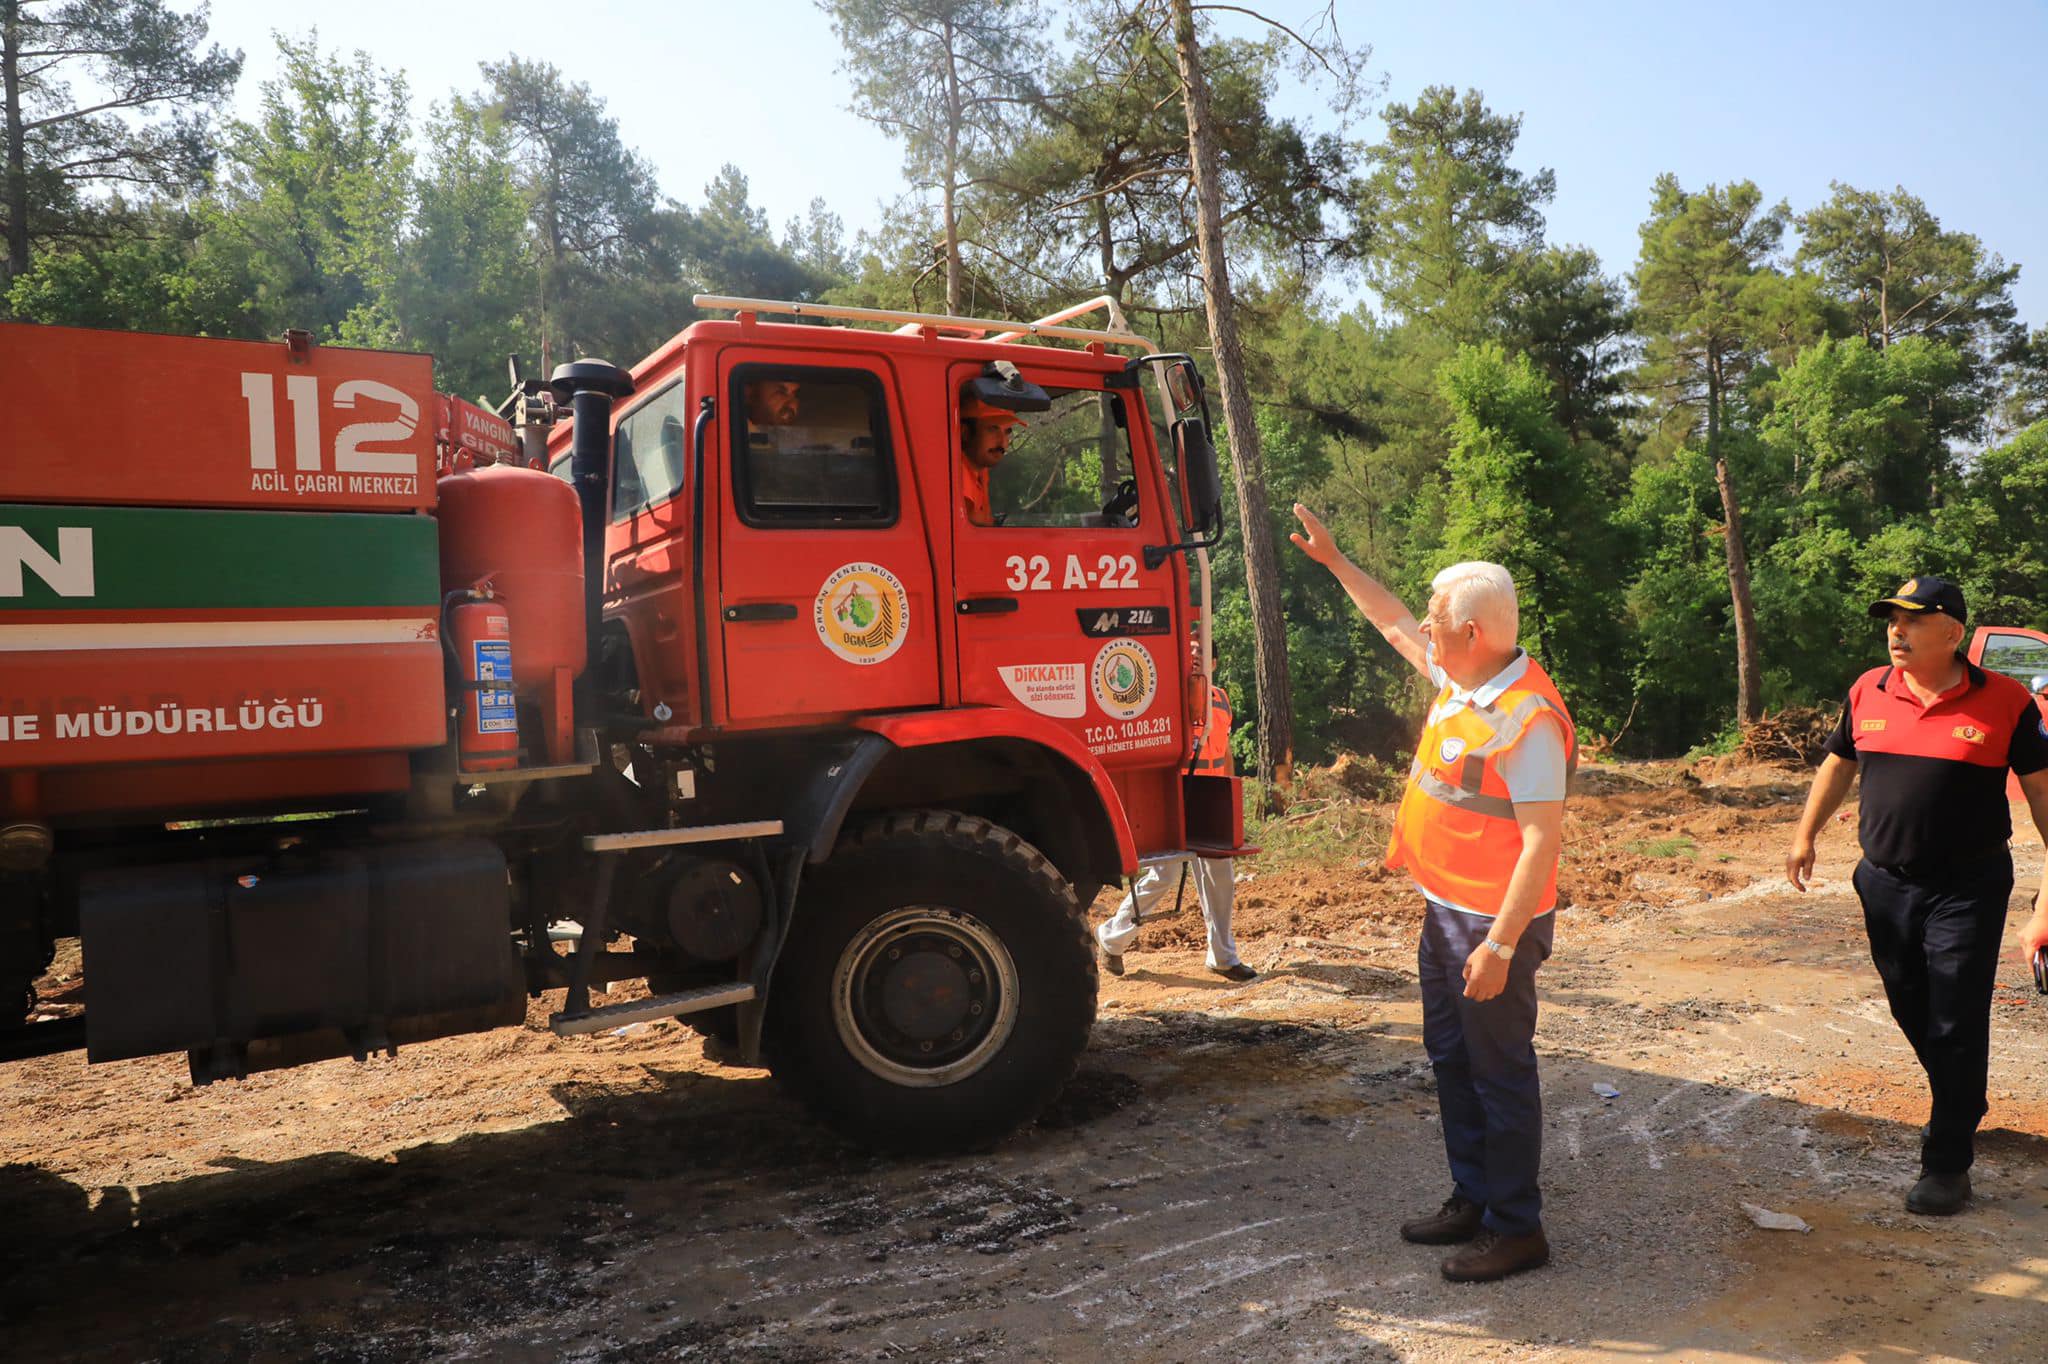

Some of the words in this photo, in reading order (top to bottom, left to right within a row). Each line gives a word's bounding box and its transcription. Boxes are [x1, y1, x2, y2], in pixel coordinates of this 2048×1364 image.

[241, 372, 419, 474] 112
[252, 471, 289, 492] ACİL
[349, 475, 418, 495] MERKEZİ
[1005, 555, 1052, 592] 32
[1062, 554, 1139, 590] A-22
[55, 697, 323, 739] MÜDÜRLÜĞÜ
[1085, 725, 1118, 743] T.C.O.
[1120, 716, 1171, 738] 10.08.281
